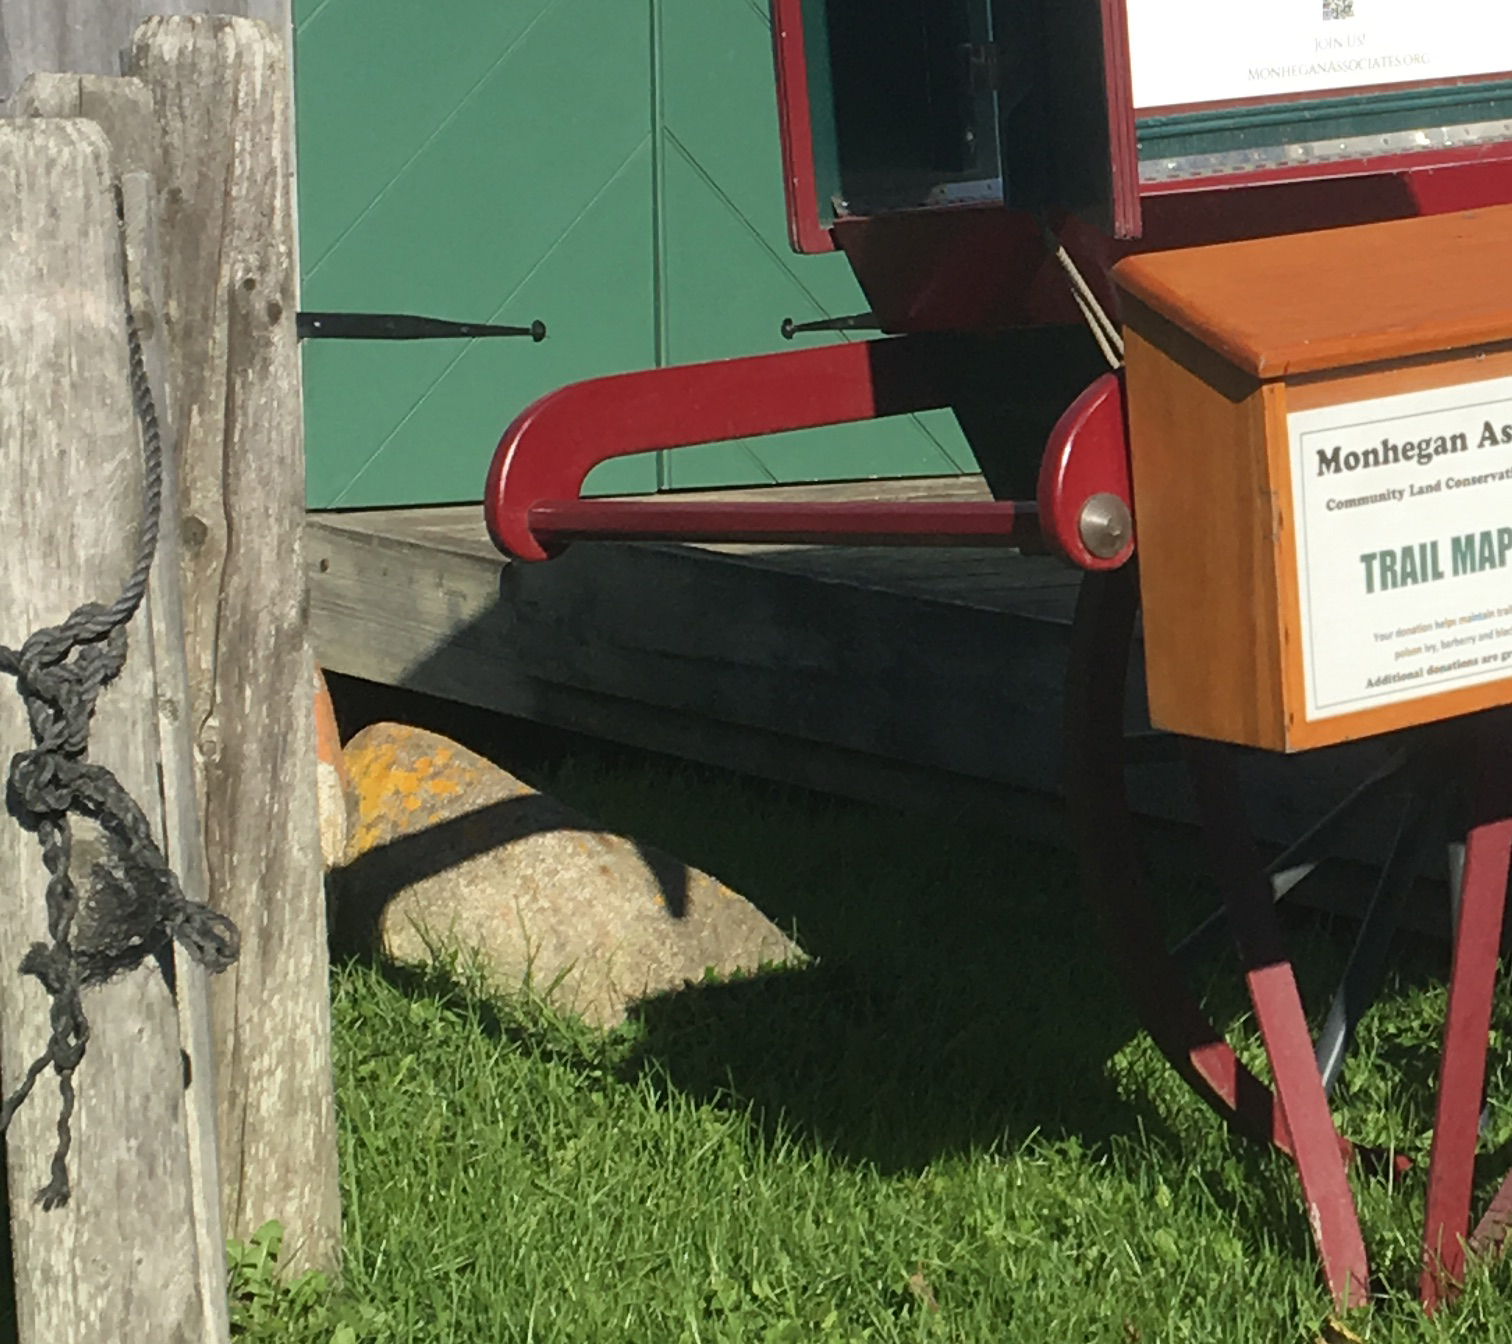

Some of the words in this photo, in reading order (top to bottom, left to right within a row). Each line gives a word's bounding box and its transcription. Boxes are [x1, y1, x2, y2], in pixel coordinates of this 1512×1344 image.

[1315, 431, 1468, 477] Monhegan
[1325, 488, 1405, 511] Community
[1408, 478, 1441, 497] Land
[1359, 540, 1444, 594] TRAIL
[1372, 630, 1394, 642] Your
[1394, 622, 1433, 638] donation
[1433, 617, 1457, 629] helps
[1458, 608, 1495, 625] maintain
[1365, 666, 1423, 689] Additional
[1425, 657, 1479, 676] donations
[1480, 653, 1498, 664] are
